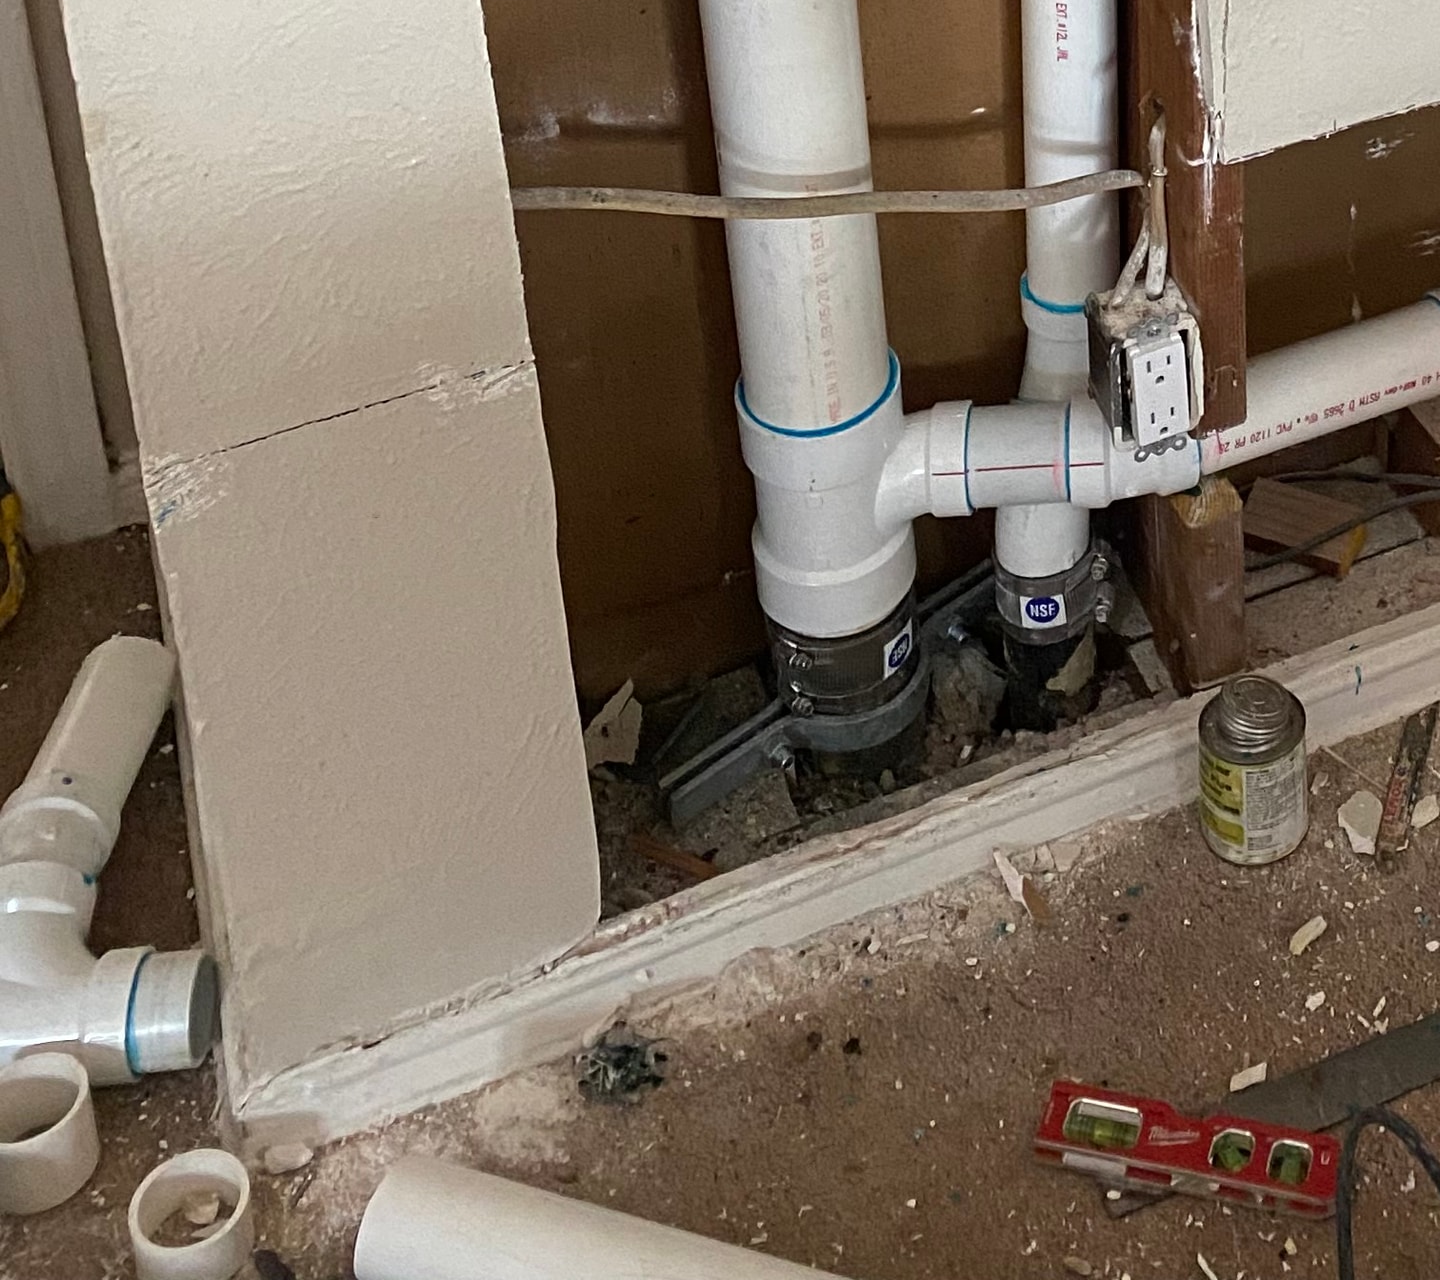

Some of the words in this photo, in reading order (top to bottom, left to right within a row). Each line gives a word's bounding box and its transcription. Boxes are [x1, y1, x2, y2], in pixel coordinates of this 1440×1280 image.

[1358, 391, 1381, 405] ASTM
[1275, 421, 1293, 434] PVC
[1234, 436, 1247, 448] PR
[1250, 428, 1271, 442] 1120
[1029, 600, 1056, 619] NSF
